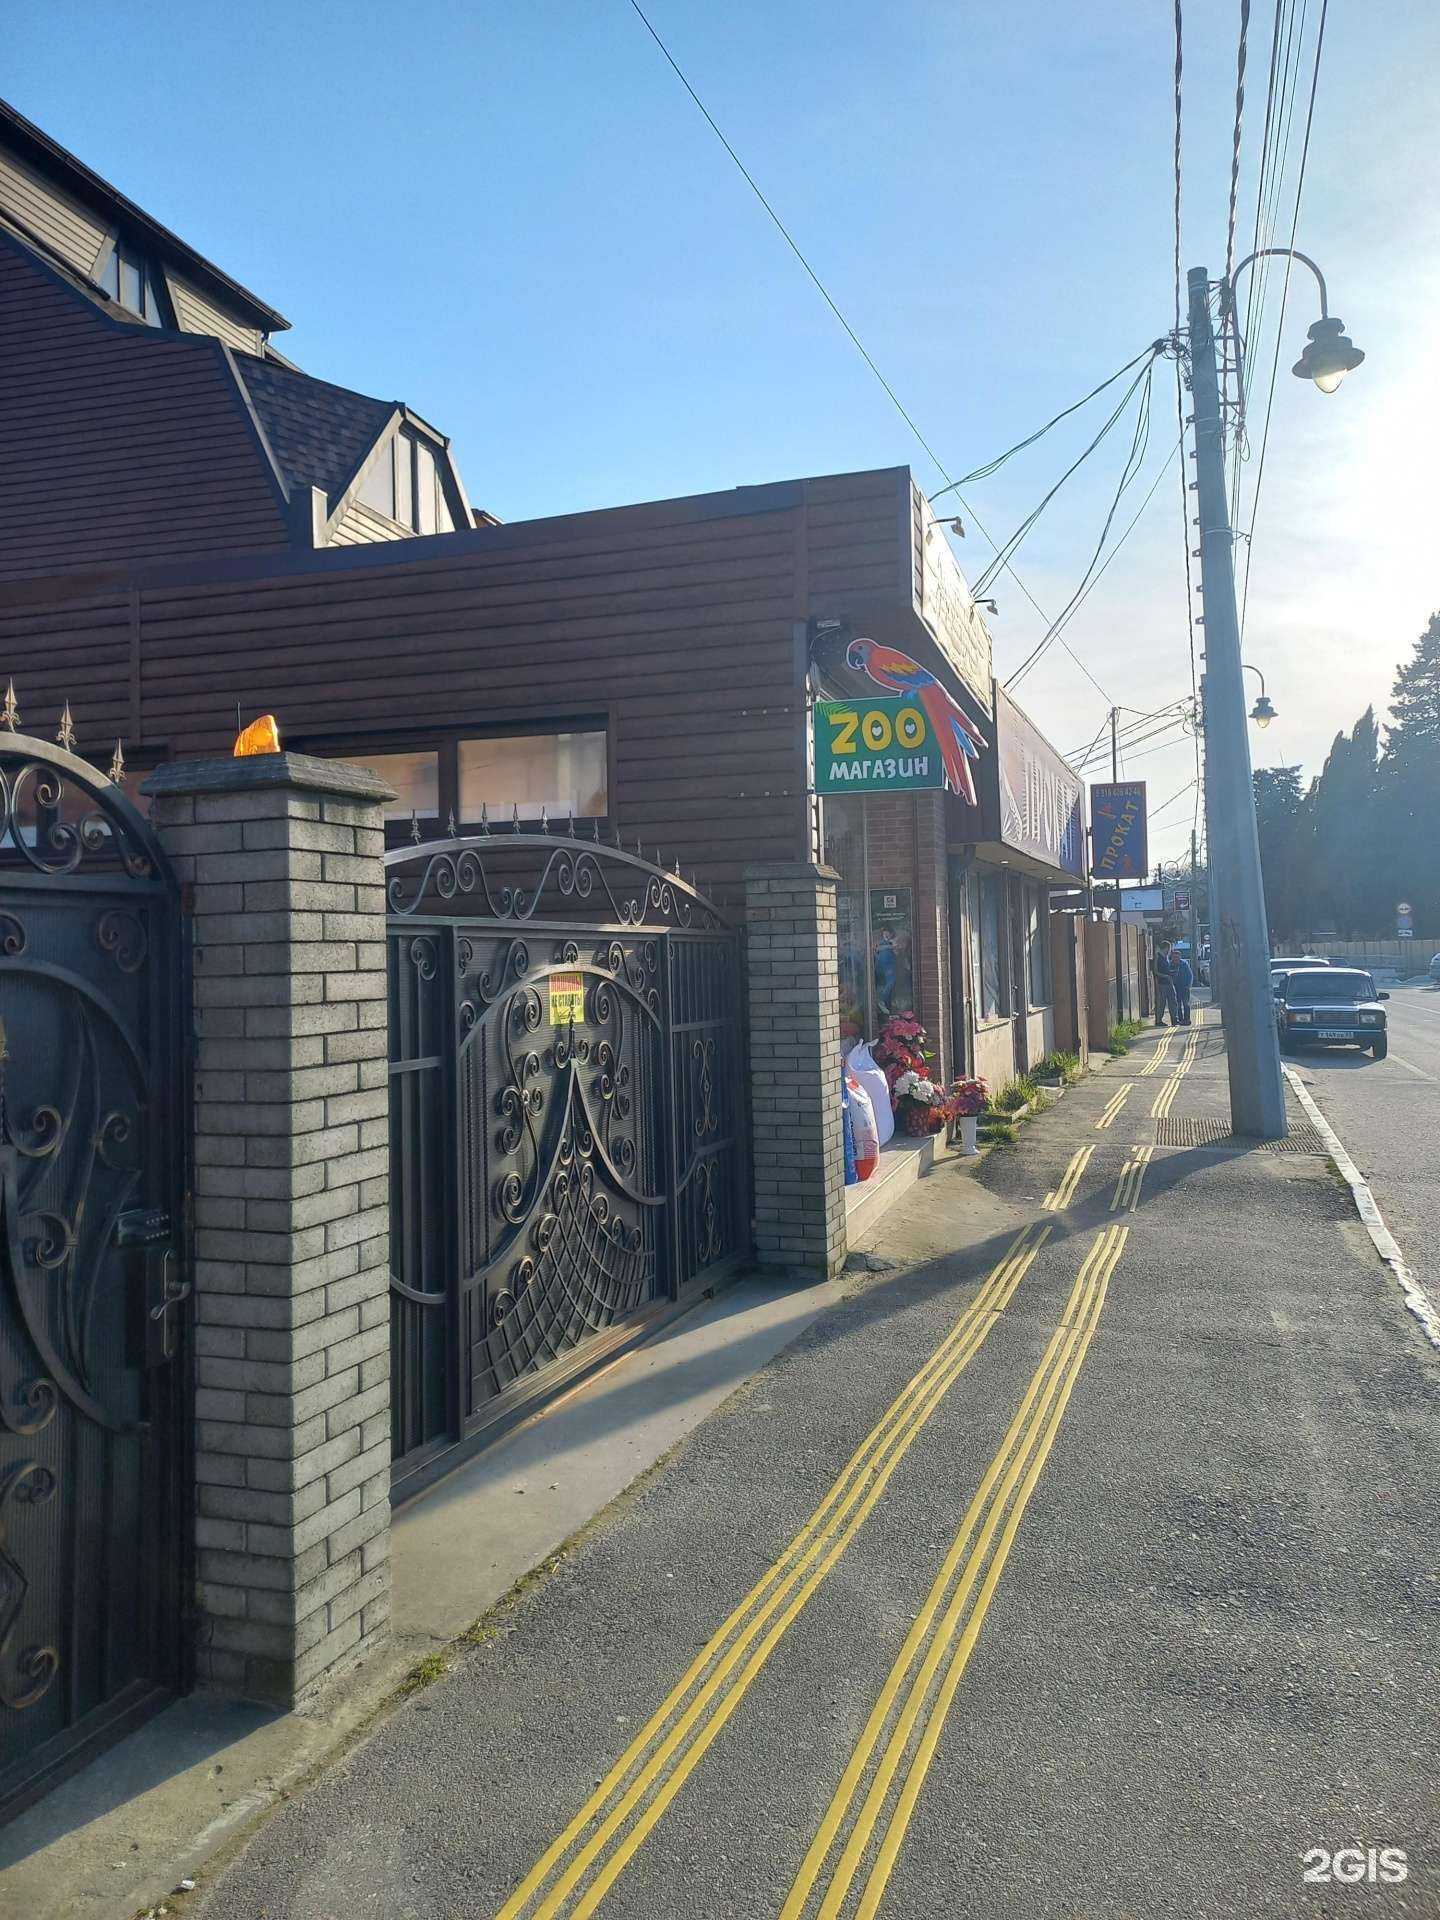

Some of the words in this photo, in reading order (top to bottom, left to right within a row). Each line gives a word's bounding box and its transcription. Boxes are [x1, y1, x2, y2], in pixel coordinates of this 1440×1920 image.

[830, 707, 926, 755] ZOO
[829, 756, 929, 781] МАГАЗИН
[1099, 801, 1138, 870] ПРОКАТ
